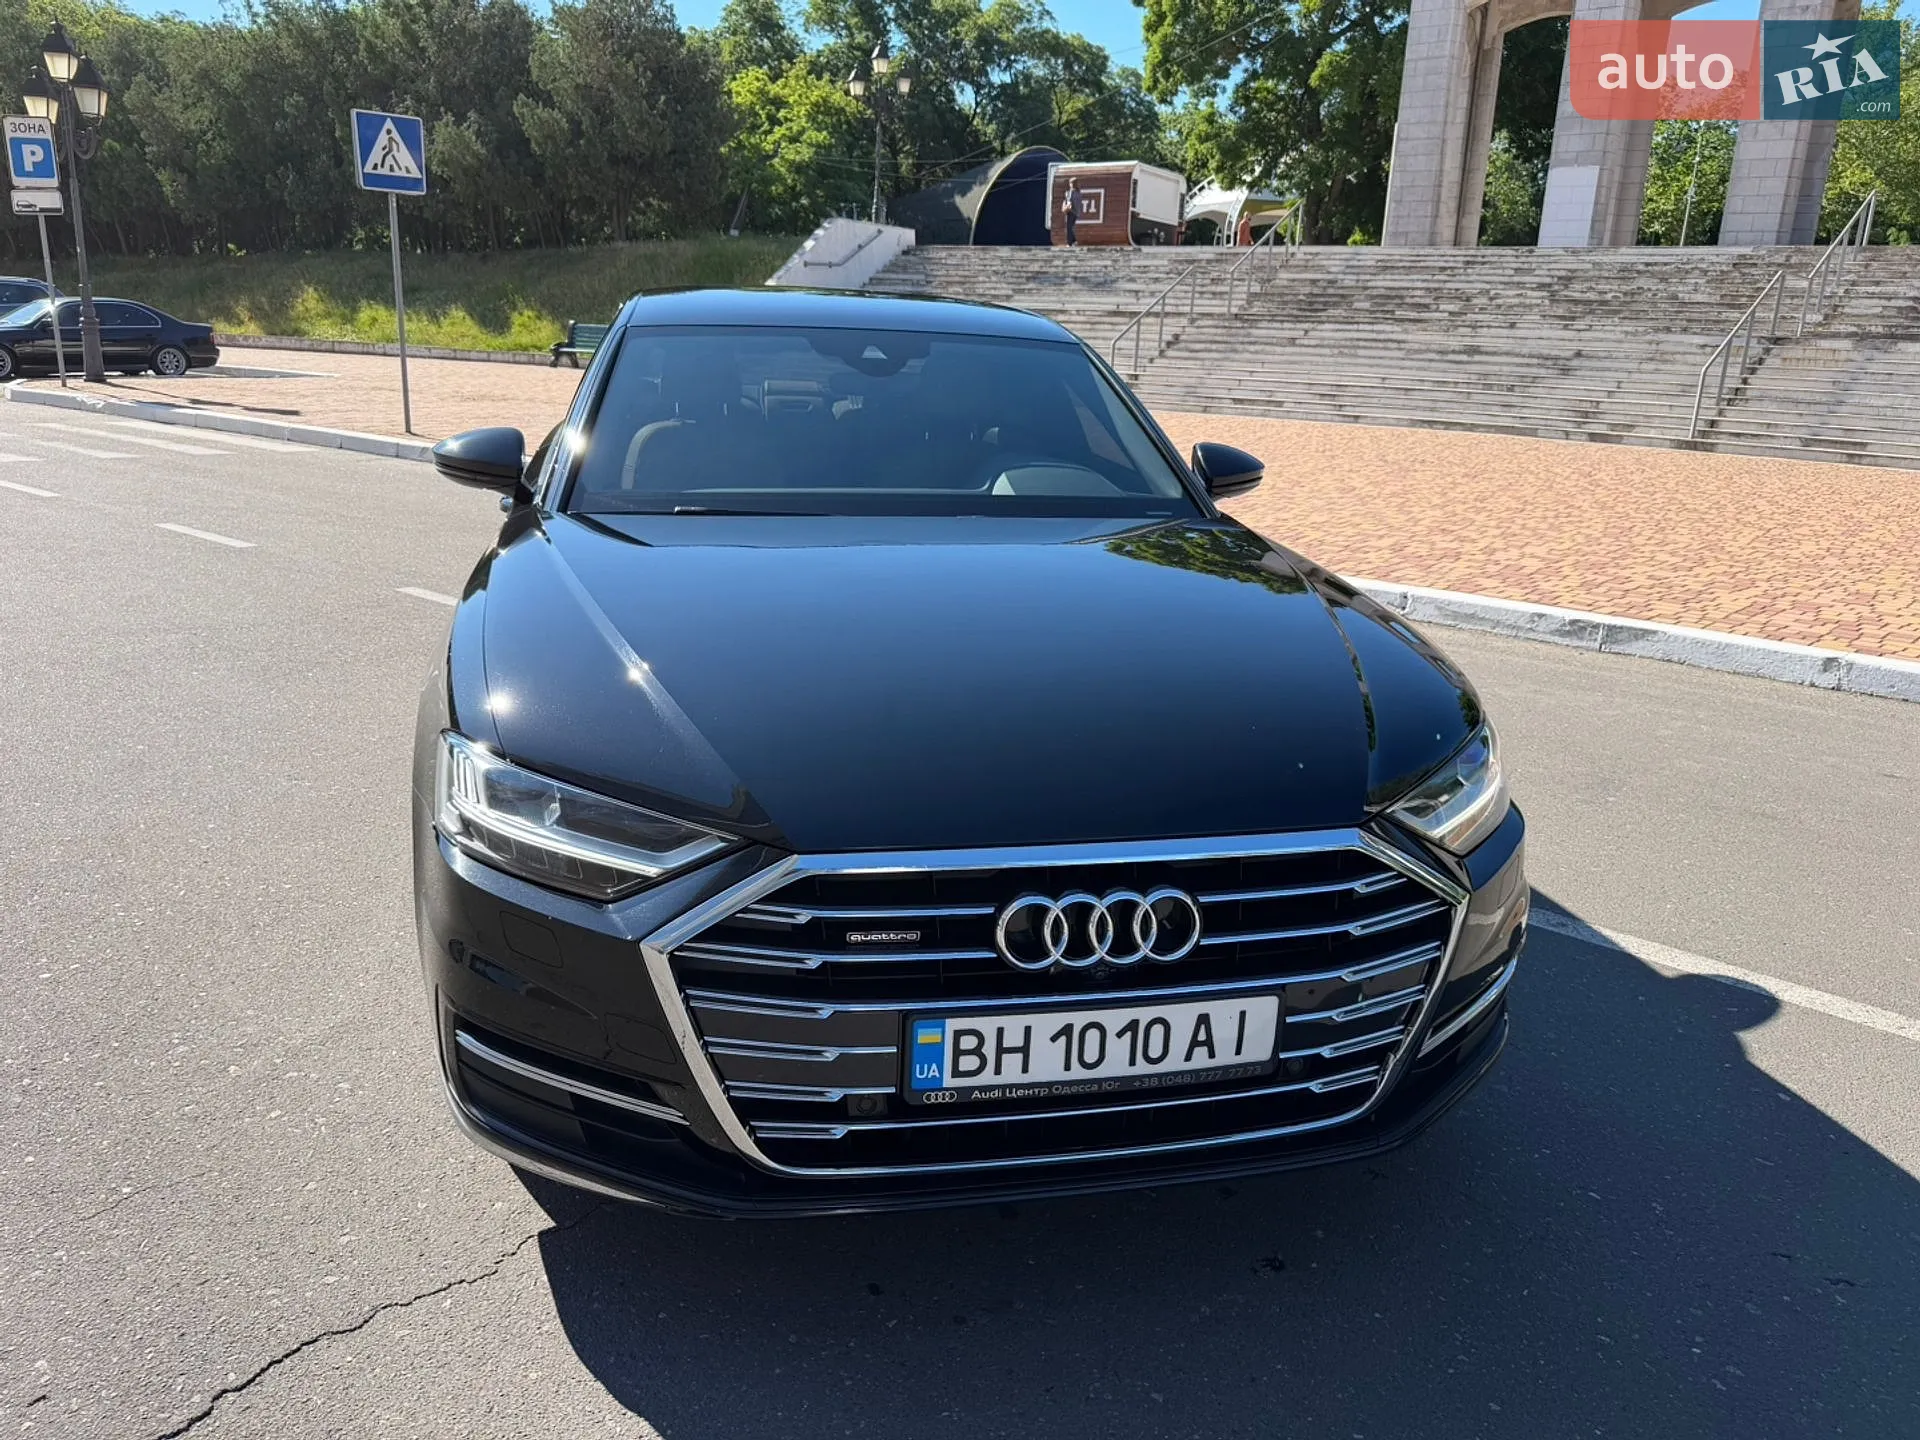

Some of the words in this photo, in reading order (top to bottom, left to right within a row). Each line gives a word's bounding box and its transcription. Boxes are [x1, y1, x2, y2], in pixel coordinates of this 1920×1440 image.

[9, 122, 47, 135] ЗОНА
[21, 143, 44, 172] P
[850, 933, 917, 943] quattro
[951, 1025, 1032, 1079] BH
[1050, 1016, 1171, 1072] 1010
[1184, 1010, 1247, 1063] AI
[915, 1063, 940, 1079] UA
[971, 1088, 1001, 1099] Audi
[1006, 1087, 1049, 1098] Центр
[1052, 1083, 1098, 1095] Одесса
[1102, 1081, 1121, 1090] Юг
